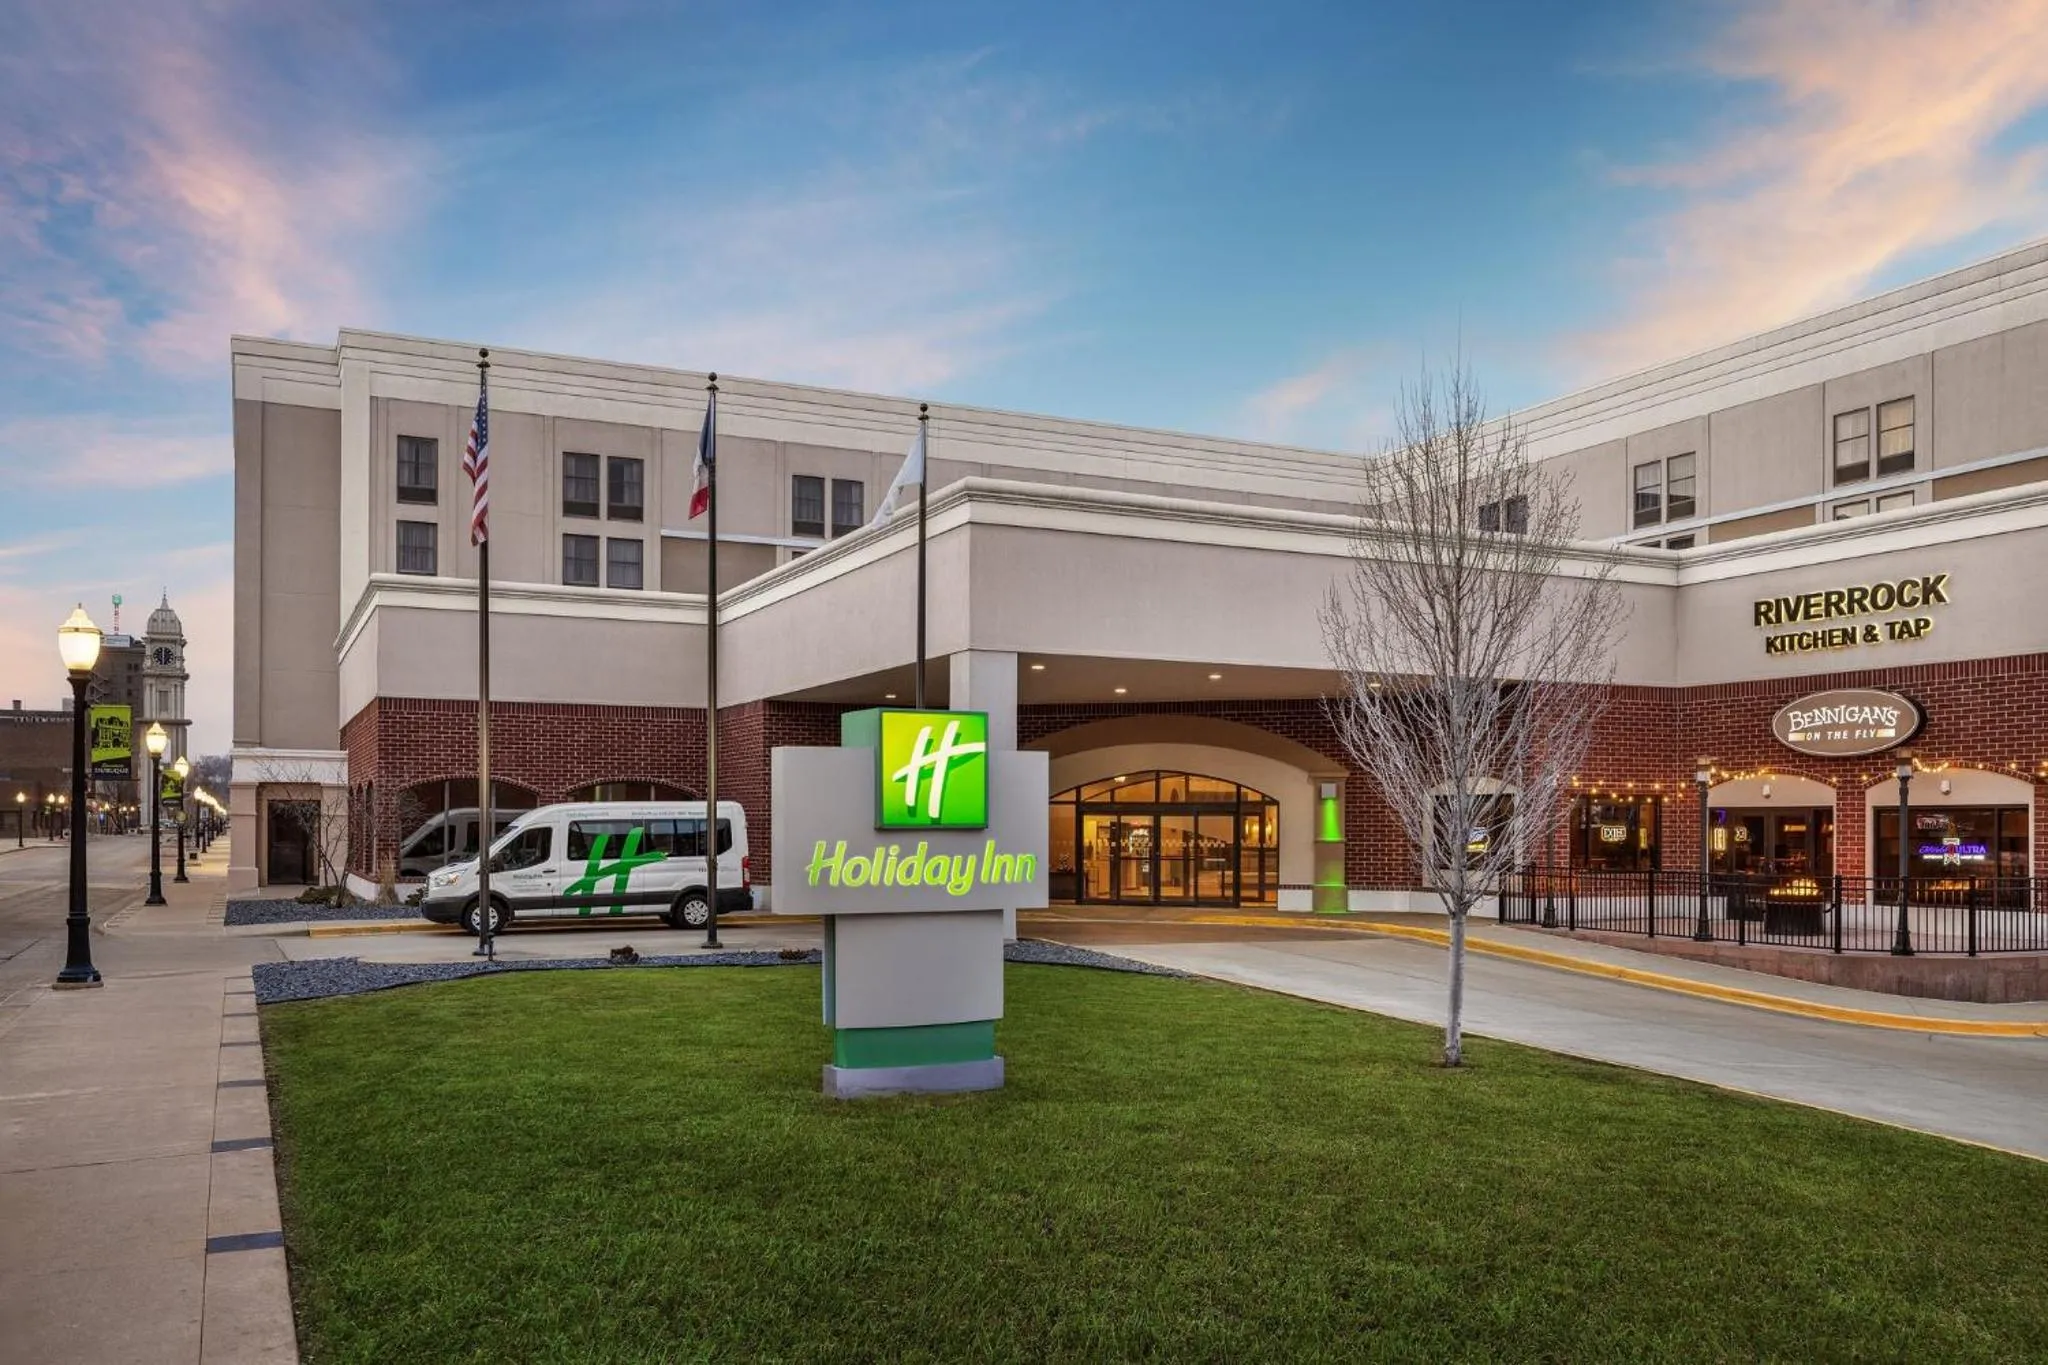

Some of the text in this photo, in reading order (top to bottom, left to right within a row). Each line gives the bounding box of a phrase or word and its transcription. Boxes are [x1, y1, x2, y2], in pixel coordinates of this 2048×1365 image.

[1753, 573, 1949, 627] RIVERROCK
[1765, 617, 1932, 654] KITCHEN & TAP
[1806, 728, 1877, 741] ON THE FLY
[805, 839, 1038, 895] Holiday Inn
